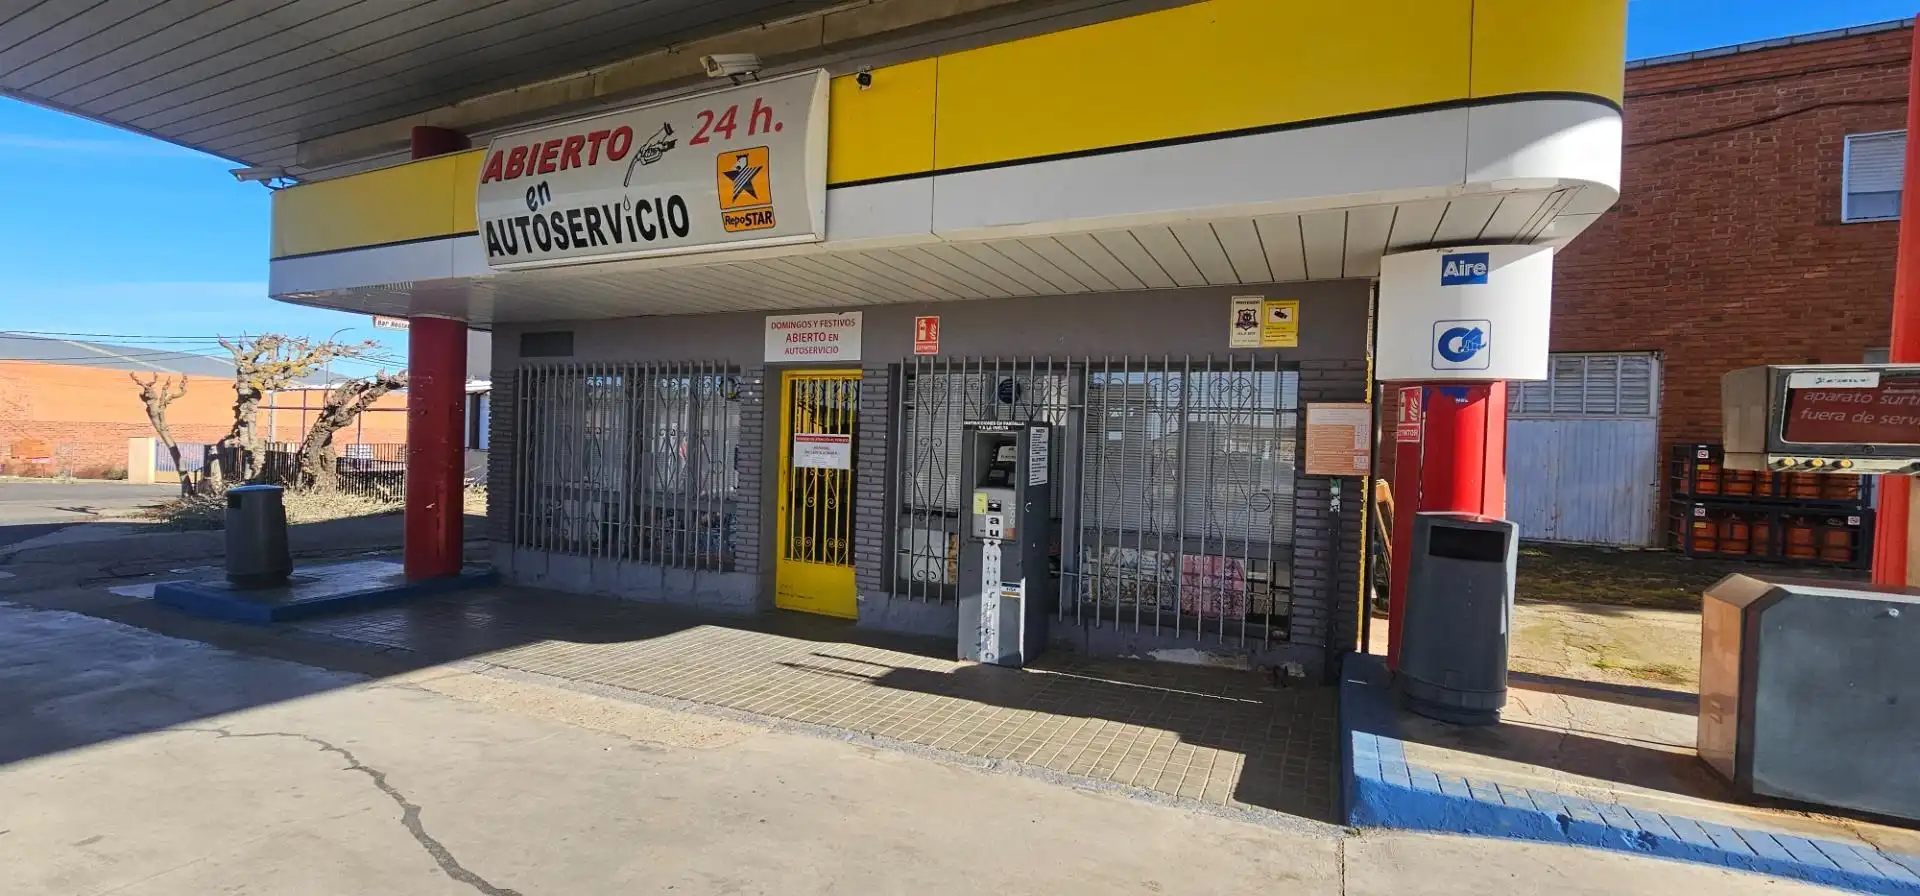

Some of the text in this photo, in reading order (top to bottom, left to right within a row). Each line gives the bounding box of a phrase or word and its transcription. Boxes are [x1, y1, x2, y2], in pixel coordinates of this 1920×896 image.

[482, 97, 784, 184] ABIERTO 24 h.
[526, 180, 551, 212] en
[1443, 260, 1488, 277] Aire
[771, 318, 856, 330] DOMINGOS Y FESTIVOS
[785, 332, 839, 343] ABIERTO EN
[784, 346, 839, 356] AUTOSERVICIO
[1803, 391, 1873, 404] aparato
[1800, 407, 1846, 421] fuera
[1852, 410, 1875, 423] de
